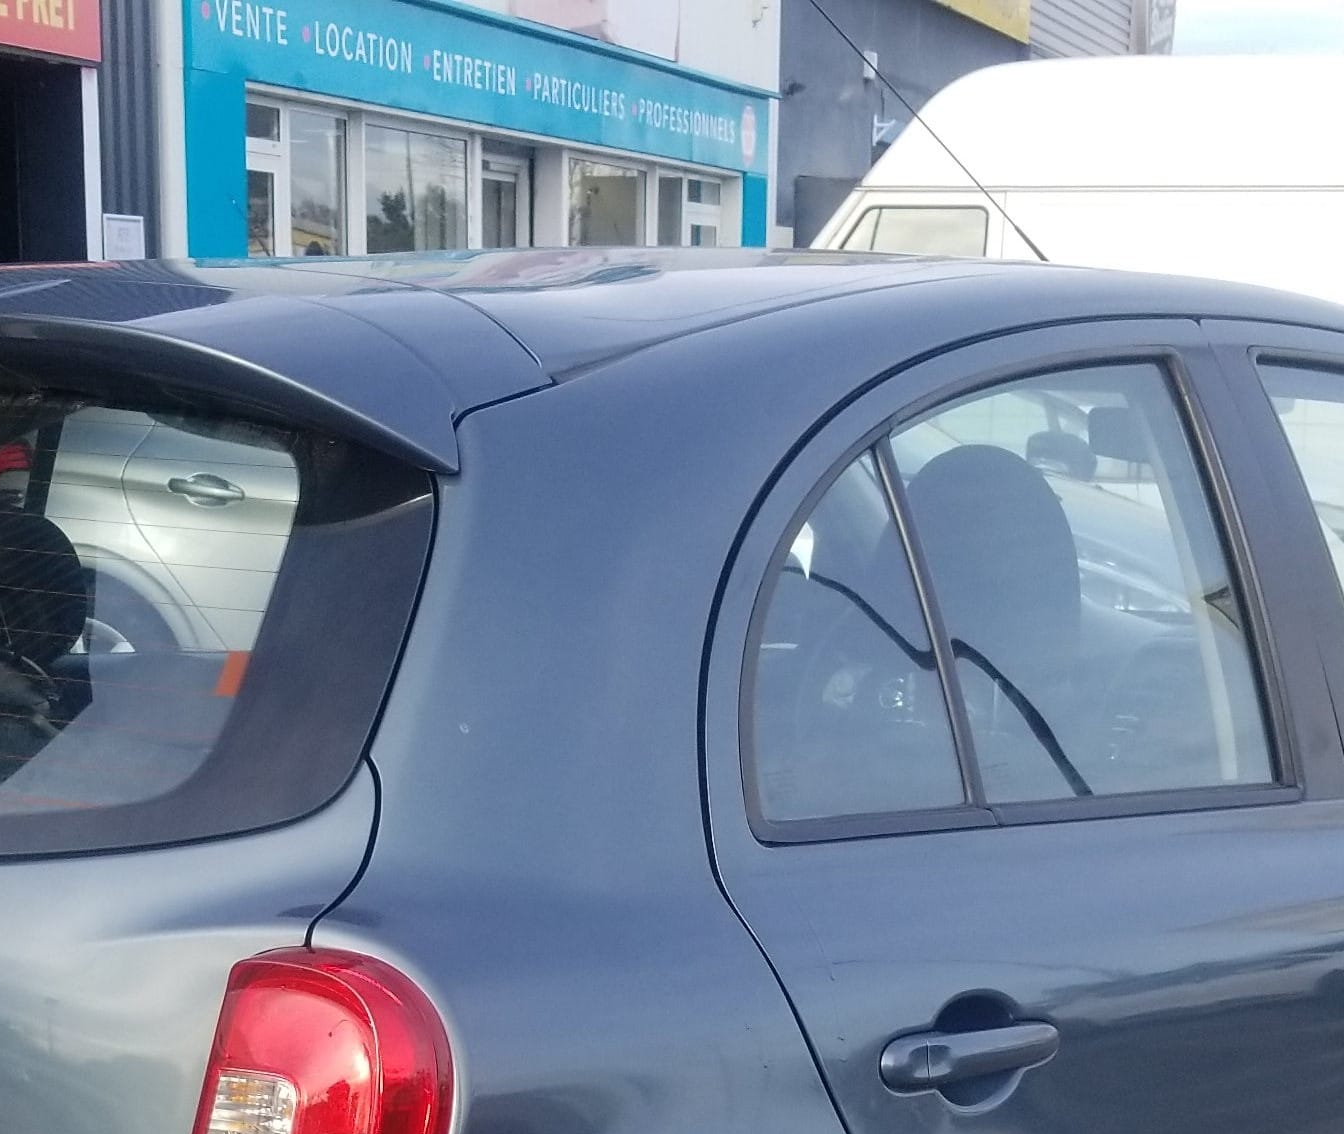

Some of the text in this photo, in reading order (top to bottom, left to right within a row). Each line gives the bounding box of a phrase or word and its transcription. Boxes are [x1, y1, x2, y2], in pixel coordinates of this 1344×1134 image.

[216, 0, 736, 144] VENTE LOCATION ENTRETIEN PARTICULIERS PROFESSIONNELS
